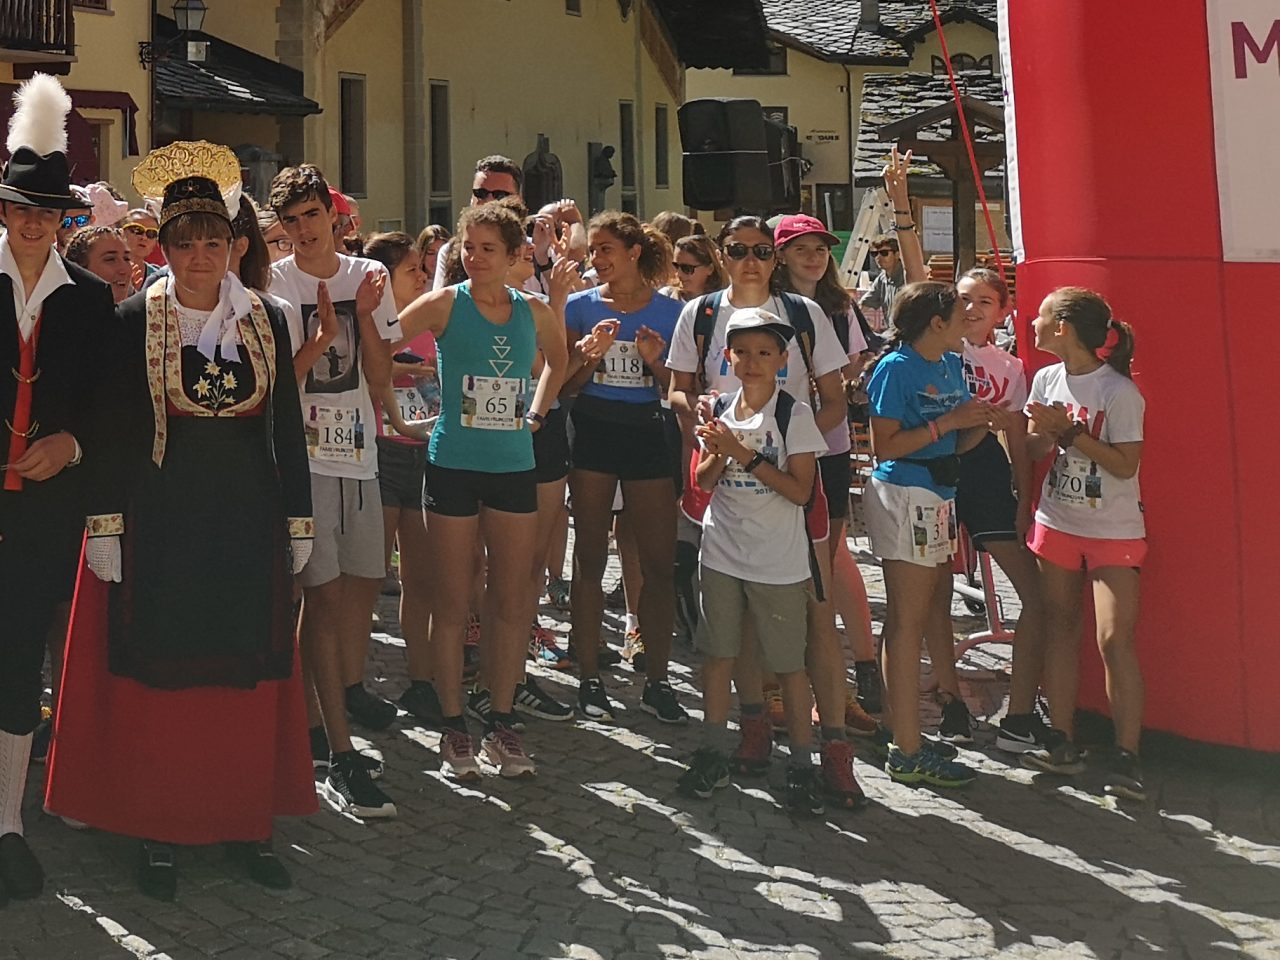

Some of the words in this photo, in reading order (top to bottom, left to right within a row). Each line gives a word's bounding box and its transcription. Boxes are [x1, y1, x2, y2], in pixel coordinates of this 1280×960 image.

[610, 357, 640, 374] 118
[485, 397, 508, 414] 65
[324, 427, 353, 445] 184
